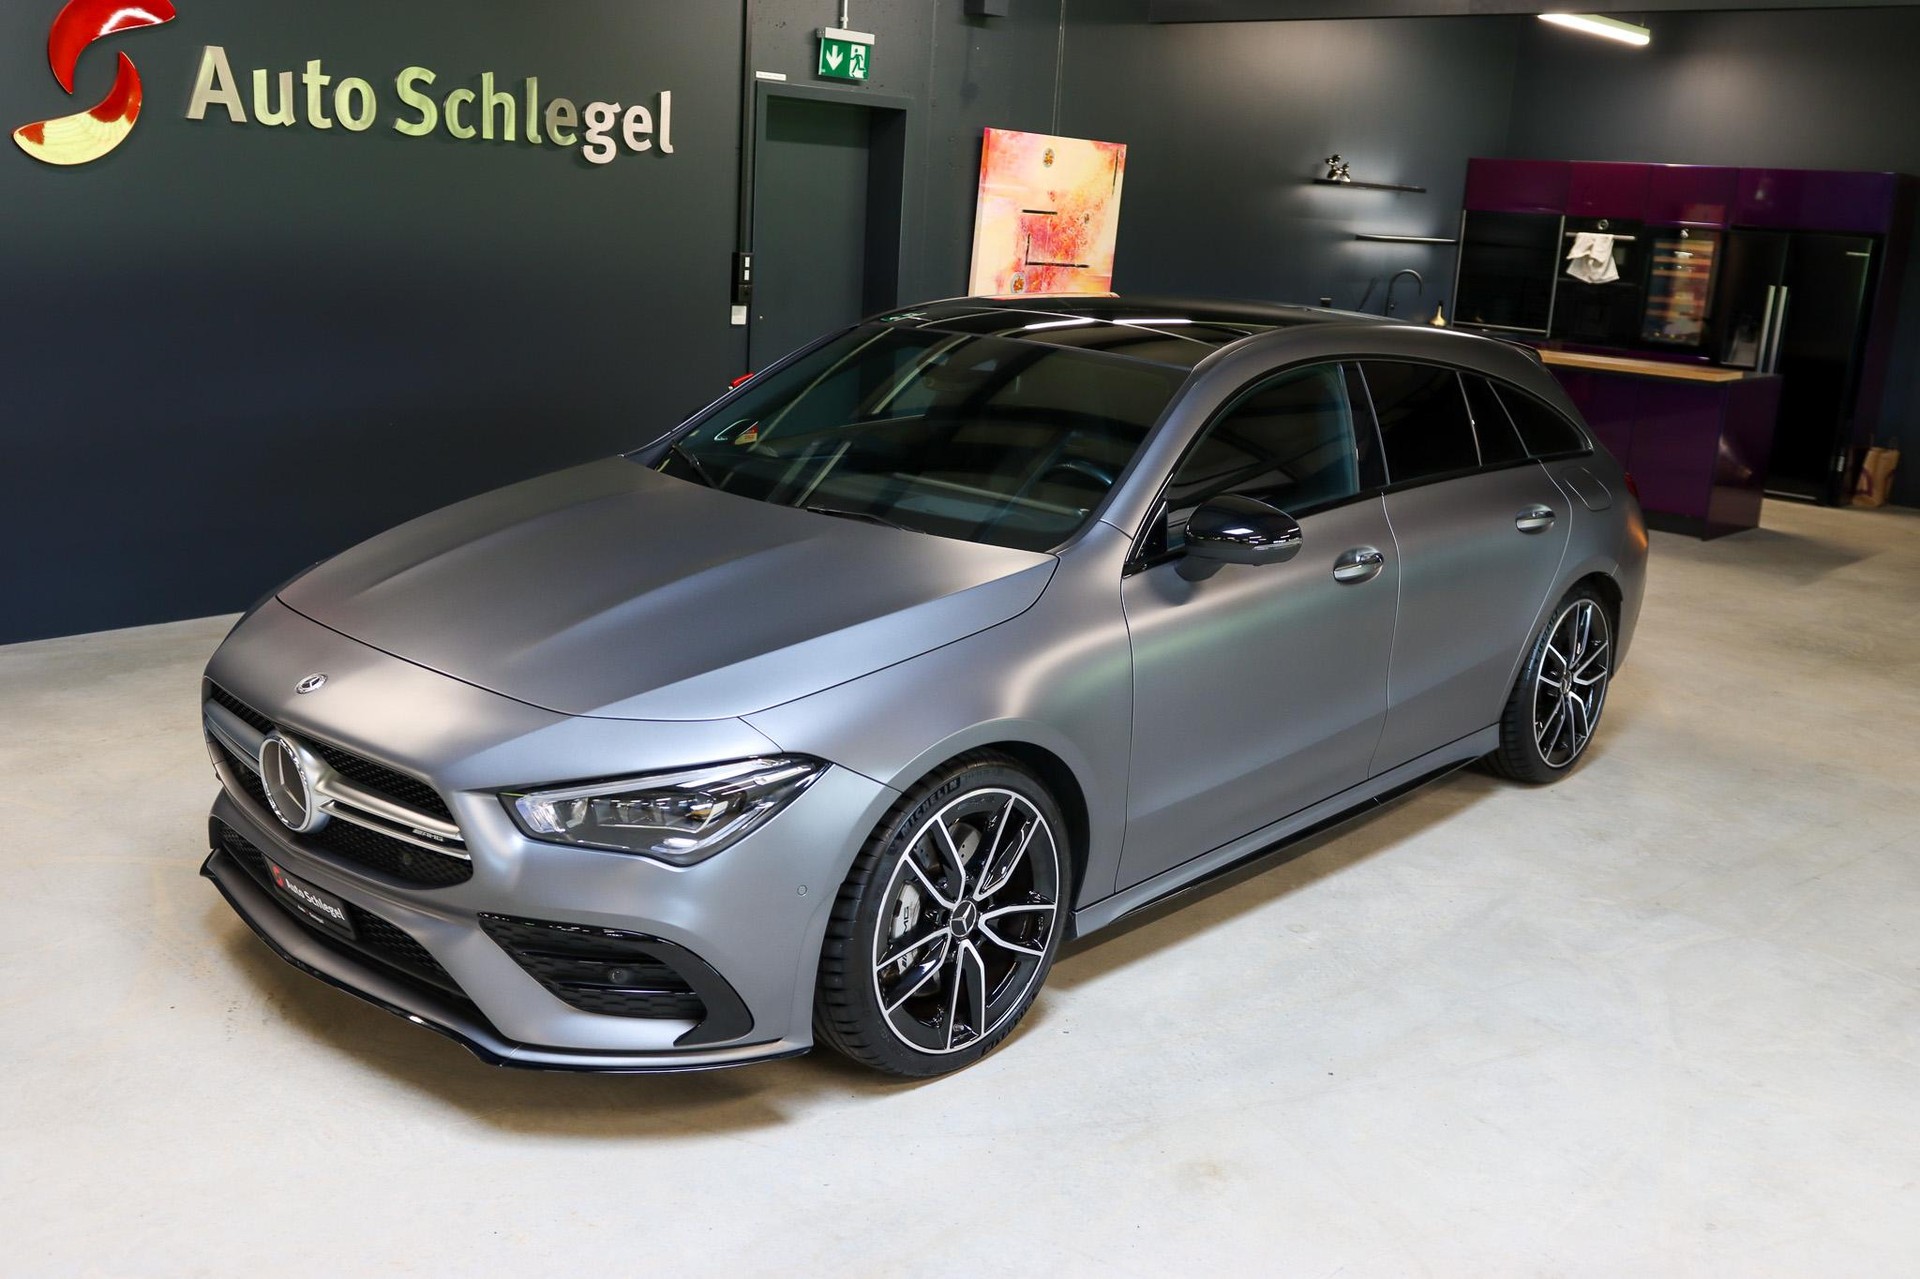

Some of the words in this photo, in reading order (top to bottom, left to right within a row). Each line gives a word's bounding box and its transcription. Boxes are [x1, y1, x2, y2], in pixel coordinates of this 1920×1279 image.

[185, 45, 377, 131] Auto
[393, 66, 674, 164] Schlegel
[900, 778, 959, 838] MICHELIN
[303, 890, 346, 921] Schlegel
